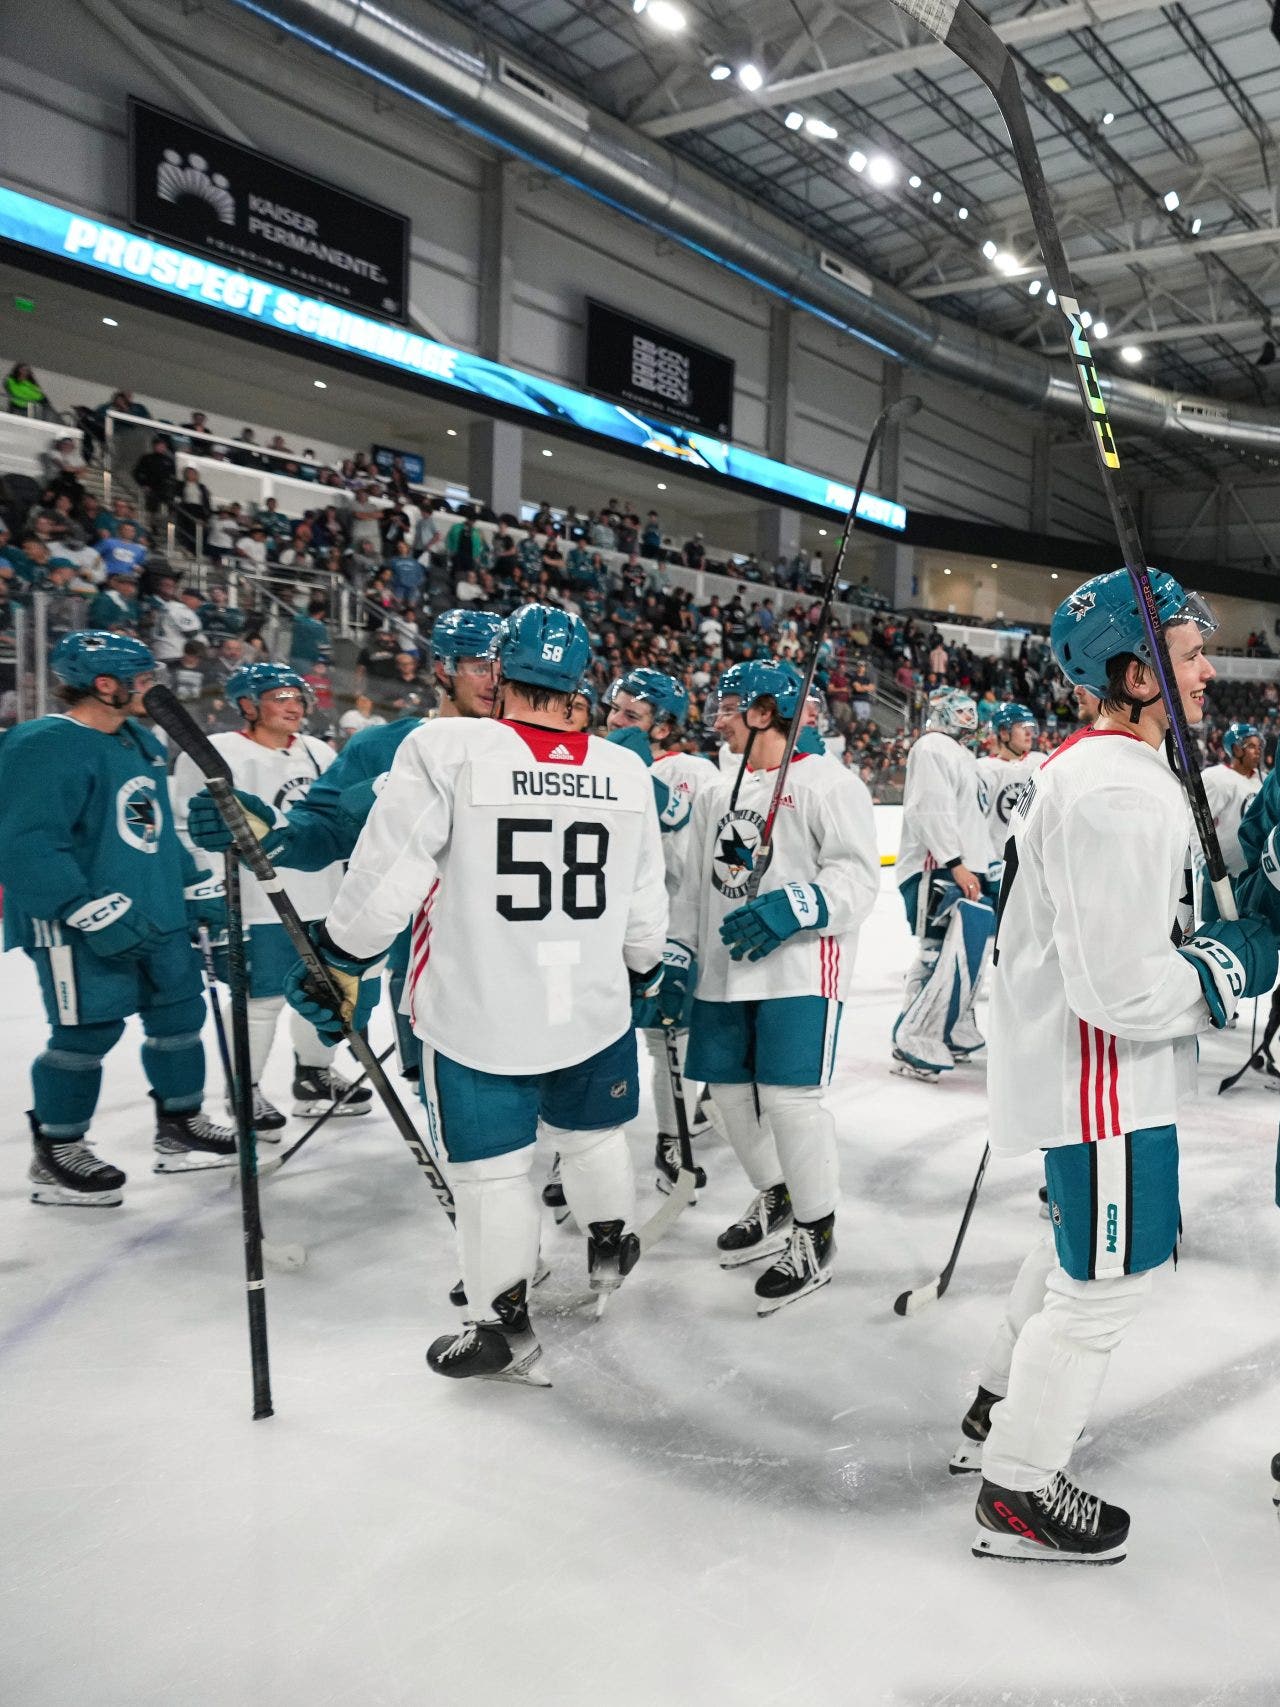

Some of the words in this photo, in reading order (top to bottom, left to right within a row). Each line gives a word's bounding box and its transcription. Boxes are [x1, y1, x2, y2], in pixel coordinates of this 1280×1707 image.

[249, 193, 319, 236] KAISER
[63, 218, 273, 316] PROSPECT
[273, 293, 459, 379] SCRIMMAGE
[541, 643, 564, 663] 58
[548, 753, 574, 761] adidas
[512, 769, 618, 801] RUSSELL
[496, 818, 610, 922] 58
[76, 896, 127, 930] CCM
[1106, 1203, 1118, 1253] CCM
